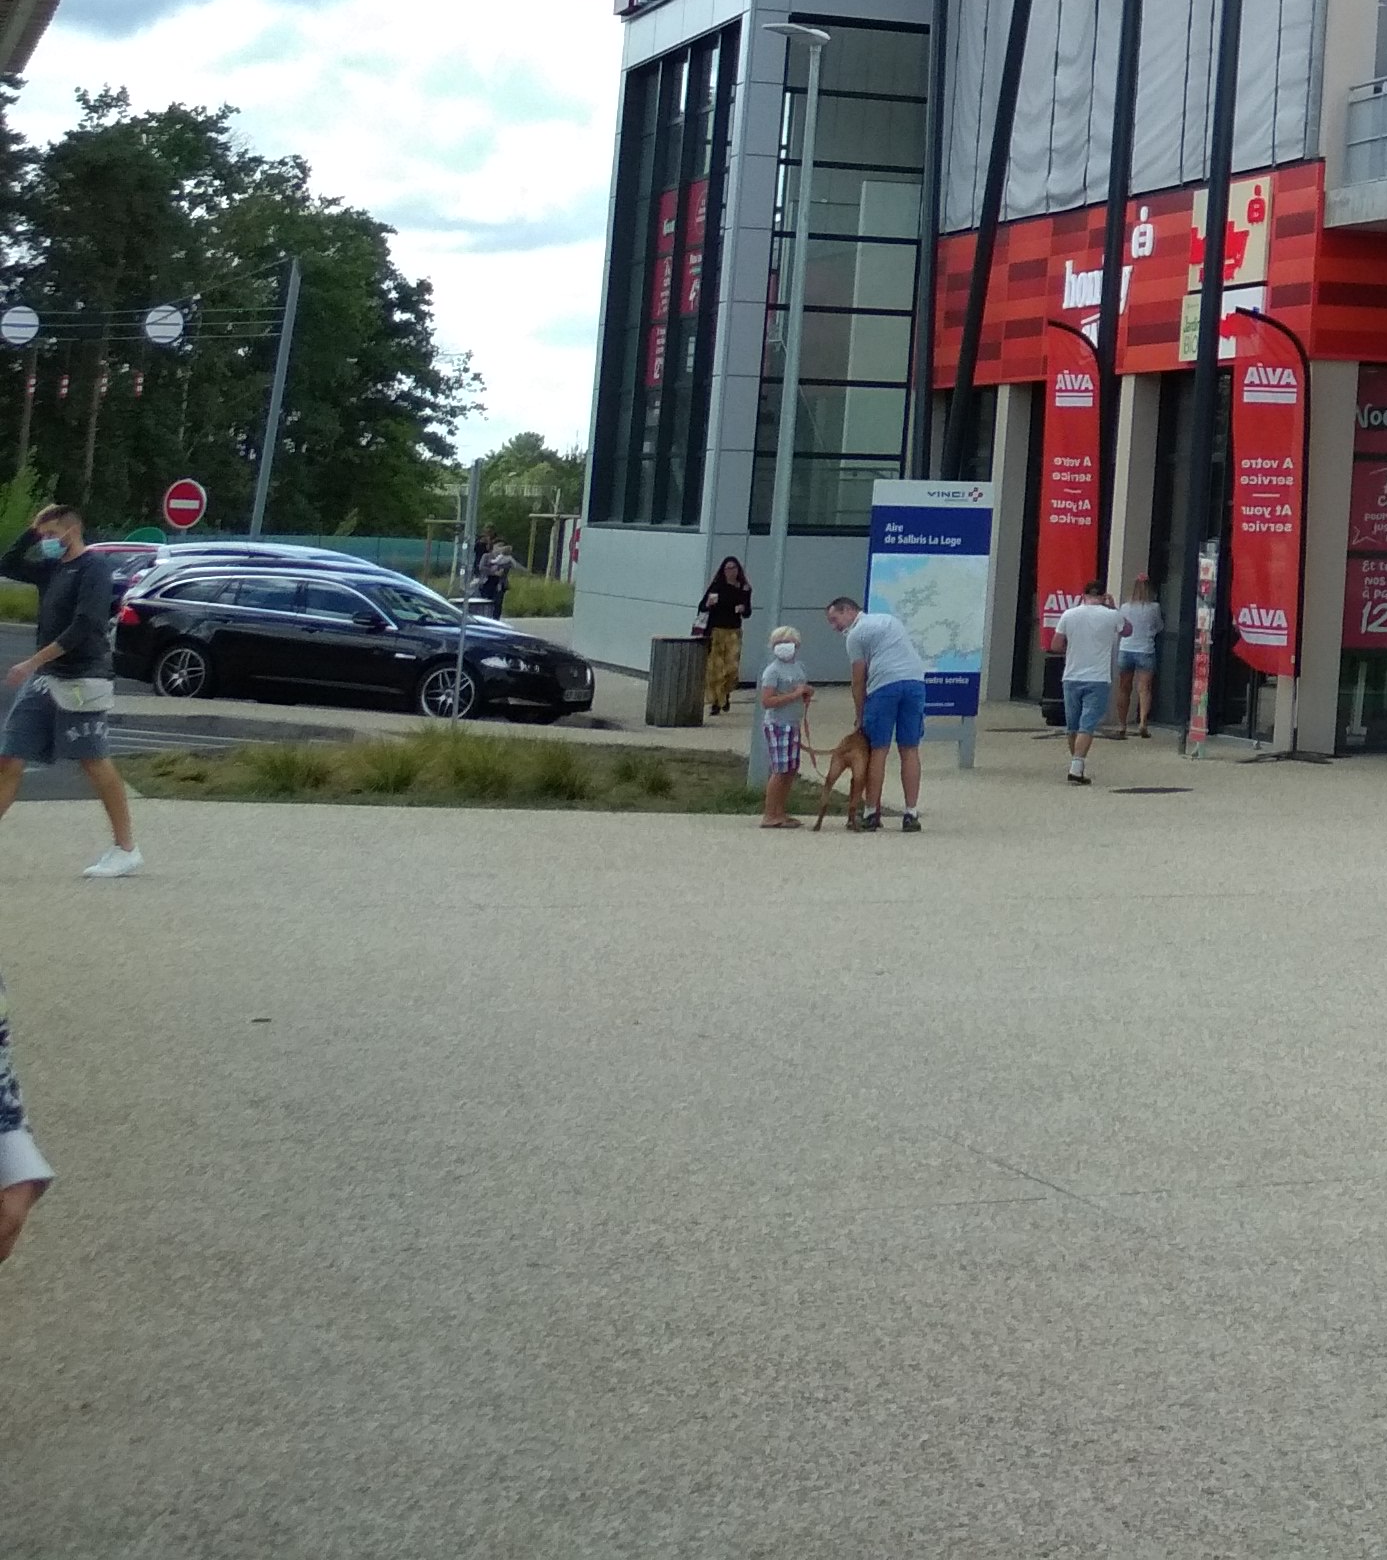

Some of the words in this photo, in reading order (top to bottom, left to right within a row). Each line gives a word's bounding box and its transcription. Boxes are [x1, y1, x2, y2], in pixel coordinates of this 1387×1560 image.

[1364, 512, 1387, 522] pour
[885, 522, 904, 532] Aire
[884, 535, 896, 544] de
[897, 534, 927, 545] Salbris
[928, 535, 939, 545] La
[940, 536, 962, 548] Loge
